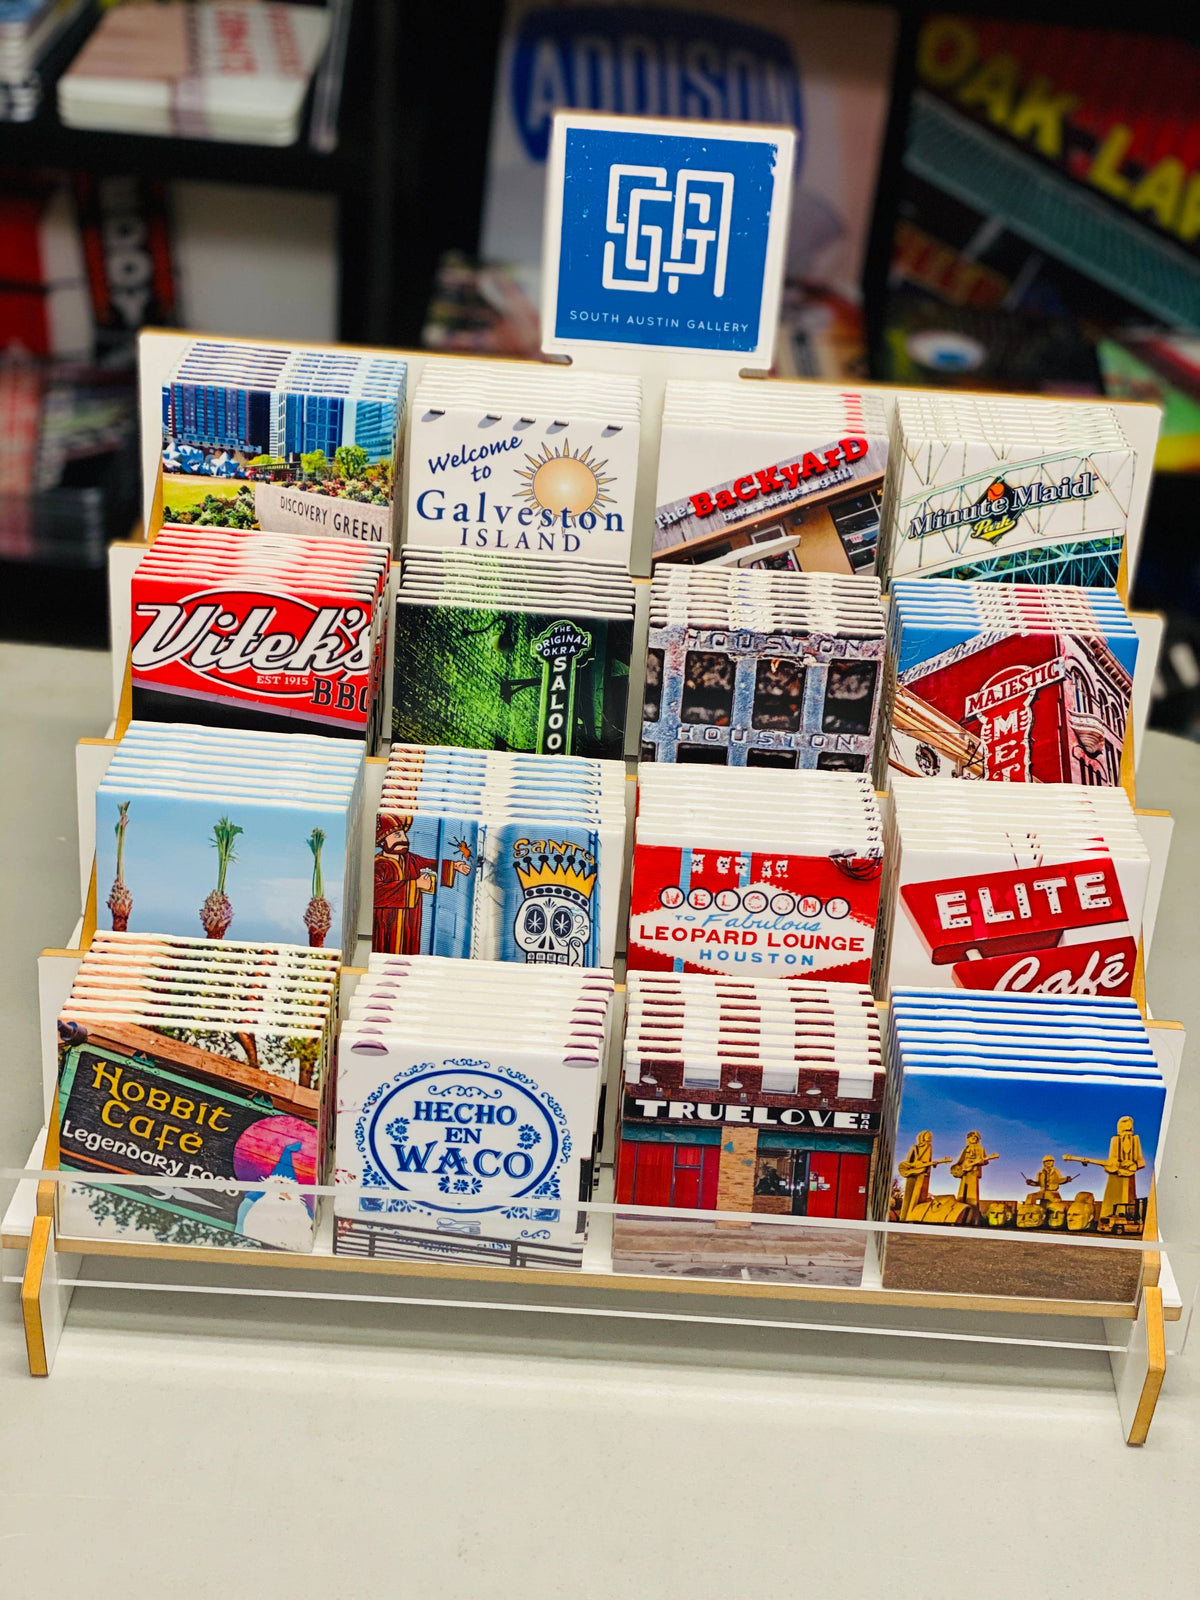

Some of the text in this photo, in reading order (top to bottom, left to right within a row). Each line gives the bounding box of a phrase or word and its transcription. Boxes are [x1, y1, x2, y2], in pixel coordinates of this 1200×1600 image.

[526, 34, 795, 131] ADDISON
[916, 15, 1080, 157] OAK
[569, 310, 749, 333] SOUTH AUSTIN GALLERY
[428, 436, 523, 475] Welcome
[470, 464, 492, 482] to
[280, 495, 383, 542] DISCOVERY GREEN
[416, 489, 625, 533] Galveston
[908, 471, 1094, 540] Minute Maid
[460, 527, 581, 552] ISLAND
[971, 514, 1019, 541] Park
[534, 634, 590, 652] ORIGINAL
[554, 625, 571, 634] THE
[256, 675, 309, 686] EST 1915
[967, 660, 1064, 713] MAJESTIC
[547, 656, 567, 753] SALOO
[676, 725, 858, 751] HOUSTON
[664, 889, 846, 915] WELCOME
[935, 871, 1113, 930] ELITE
[701, 913, 822, 932] Fabulous
[639, 925, 865, 952] LEOPARD LOUNGE
[699, 949, 814, 966] HOUSTON
[413, 1100, 518, 1126] HECHO
[635, 1099, 860, 1129] TRUELOVE
[444, 1127, 482, 1144] EN
[390, 1140, 535, 1180] WACO
